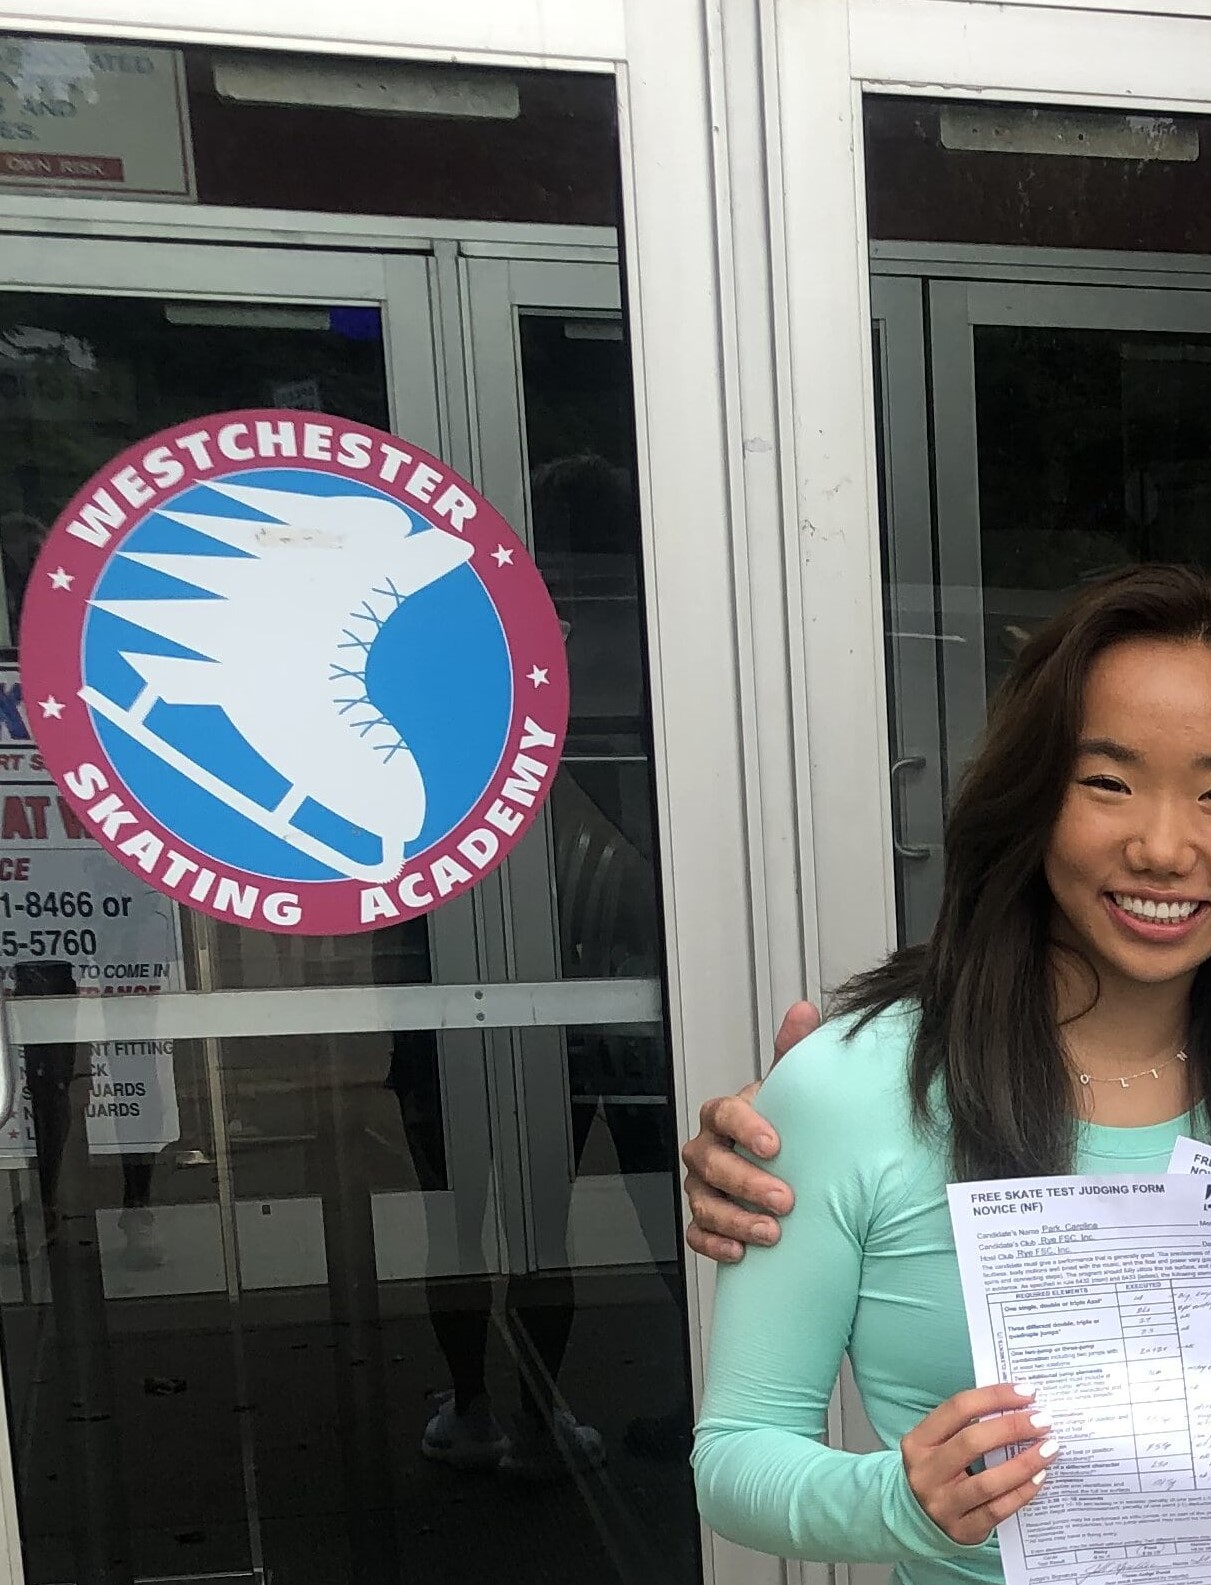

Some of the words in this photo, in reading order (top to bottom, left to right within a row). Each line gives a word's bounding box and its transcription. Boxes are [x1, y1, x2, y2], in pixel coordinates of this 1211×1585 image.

[66, 420, 478, 548] WESTCHESTER
[62, 763, 302, 926] SKATING
[361, 716, 557, 925] ACADEMY
[0, 857, 31, 881] CE
[0, 891, 94, 918] 1-8466
[102, 894, 132, 918] or
[0, 928, 98, 957] 5-5760
[79, 964, 100, 979] TO
[103, 963, 150, 978] COME
[115, 1040, 174, 1056] FITTING
[92, 1082, 147, 1097] UARDS
[86, 1102, 141, 1118] UARDS
[970, 1192, 1002, 1203] FREE
[1004, 1188, 1044, 1201] SKATE
[1045, 1186, 1076, 1198] TEST
[1078, 1184, 1131, 1196] JUDGING
[1131, 1184, 1166, 1194] FORM
[973, 1203, 1018, 1216] NOVICE
[1020, 1201, 1044, 1215] (NF)
[976, 1229, 1018, 1240] Candidate's
[1018, 1228, 1040, 1237] Name
[1064, 1222, 1100, 1232] Caroline
[978, 1240, 1019, 1252] Candidate's
[1020, 1239, 1037, 1248] Club
[997, 1253, 1015, 1262] Club
[1125, 1281, 1162, 1291] EXECUTED
